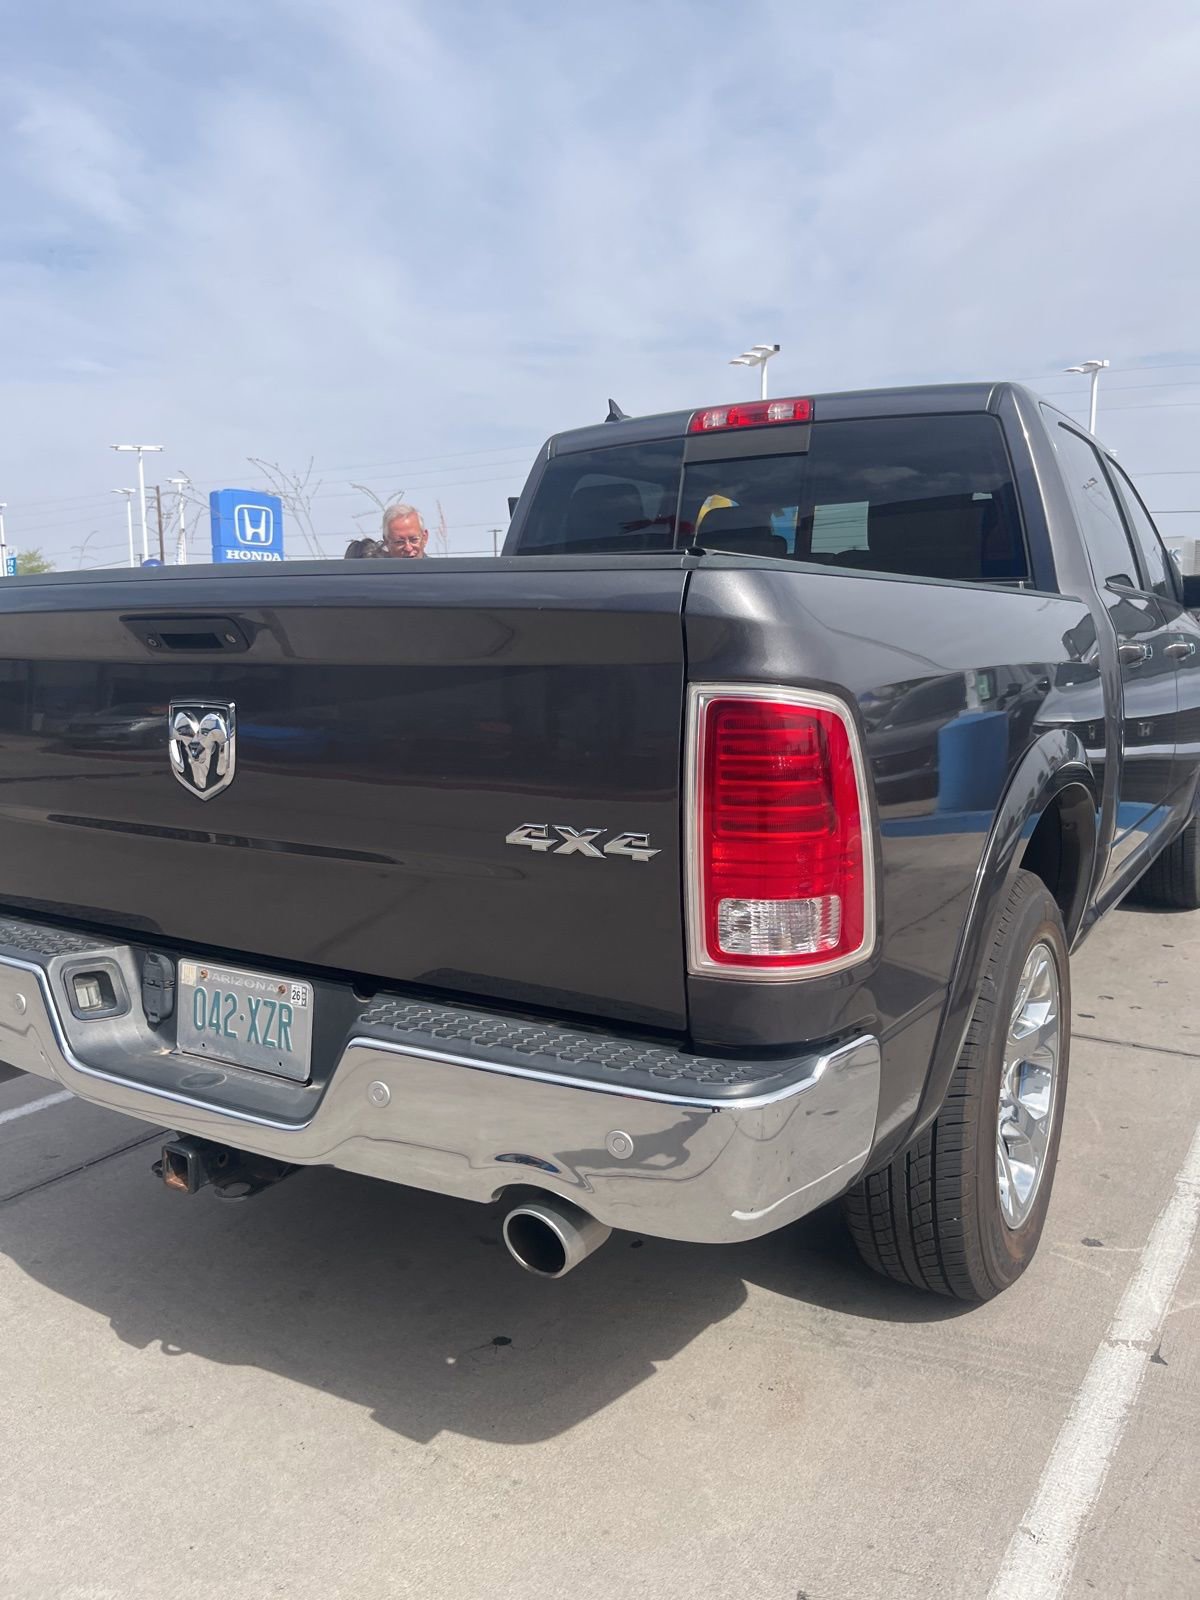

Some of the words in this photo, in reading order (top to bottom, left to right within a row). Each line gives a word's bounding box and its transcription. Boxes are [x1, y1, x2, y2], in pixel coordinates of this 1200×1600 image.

[226, 550, 282, 561] HONDA
[211, 973, 278, 993] ARIZONA
[291, 989, 301, 1001] 26
